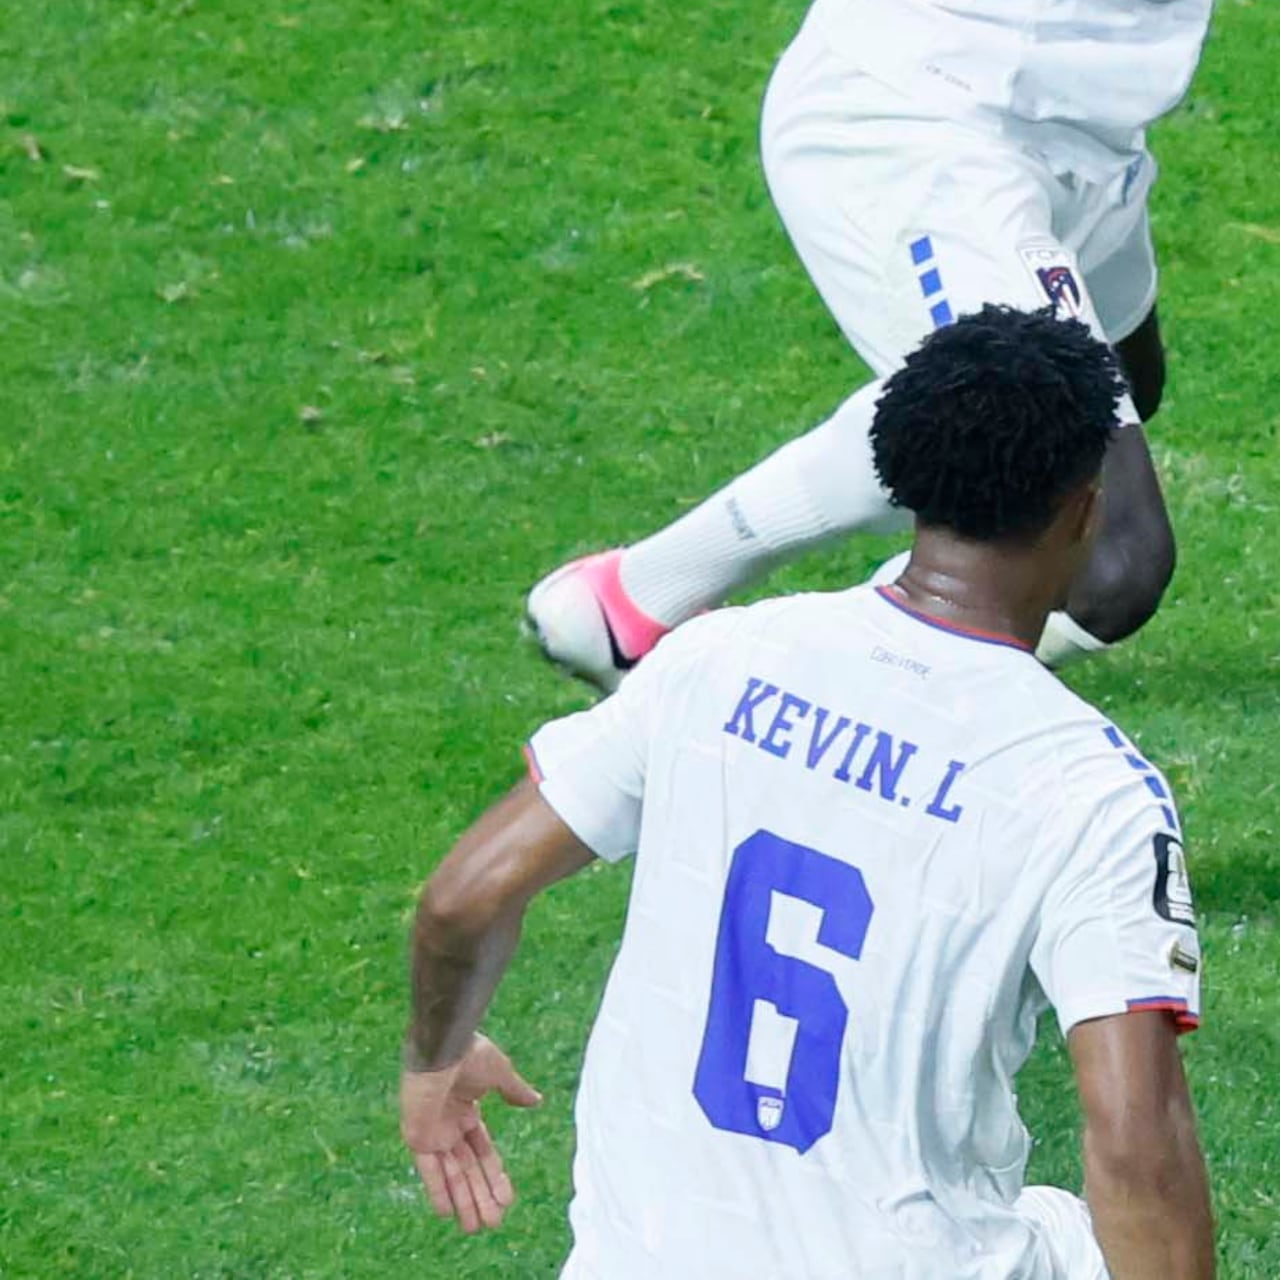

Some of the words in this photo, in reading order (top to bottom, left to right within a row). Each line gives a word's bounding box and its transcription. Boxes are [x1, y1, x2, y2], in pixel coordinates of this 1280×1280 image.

[723, 677, 918, 807] KEVIN.
[925, 760, 966, 823] L
[692, 828, 875, 1155] 6
